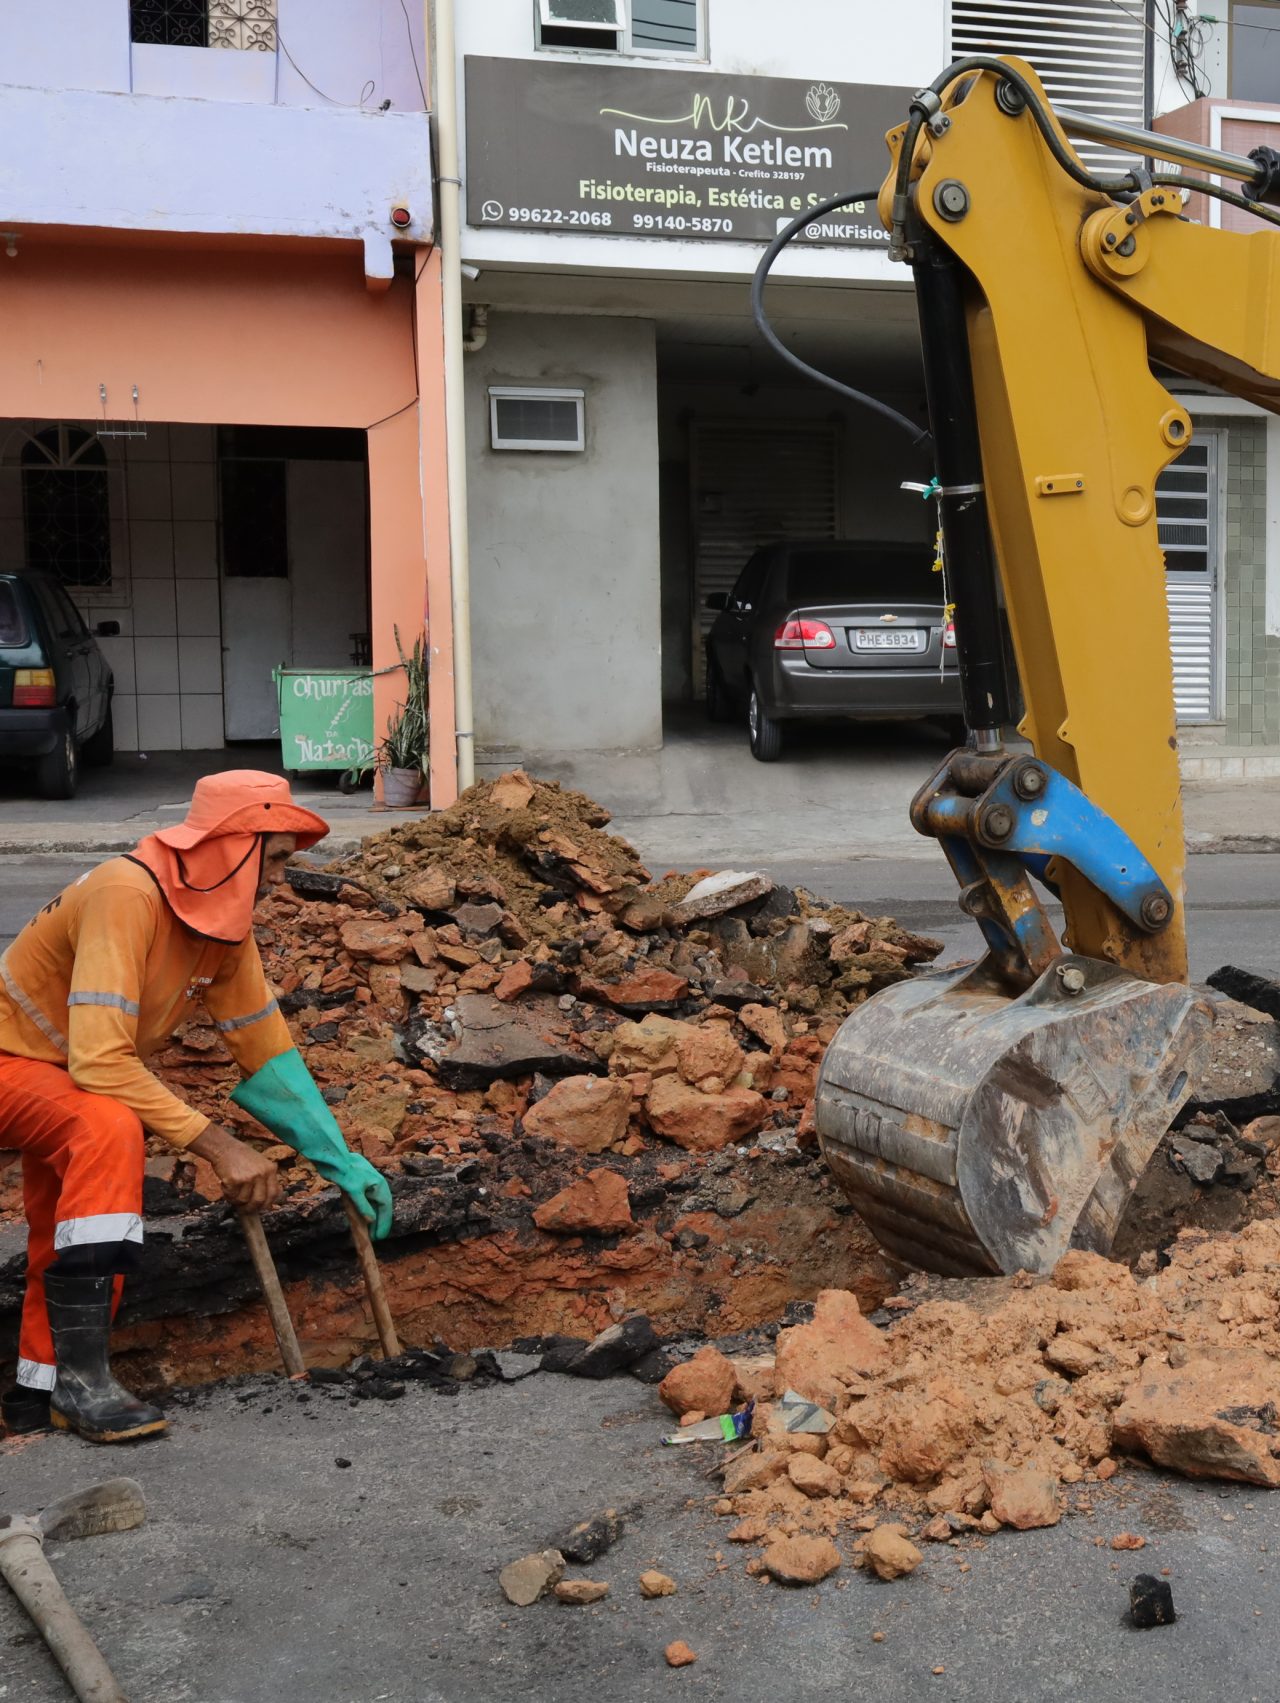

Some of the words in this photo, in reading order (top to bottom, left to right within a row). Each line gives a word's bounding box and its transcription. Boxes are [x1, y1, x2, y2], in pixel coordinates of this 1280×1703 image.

[614, 128, 712, 162] Neuza
[723, 135, 832, 168] Ketlem
[646, 162, 731, 176] Fisioterapeuta
[738, 169, 771, 179] Crefito
[772, 172, 805, 180] 328197
[579, 179, 702, 208] Fisioterapia,
[708, 186, 785, 210] Estética
[790, 197, 801, 211] e
[508, 207, 612, 226] 99622-2068
[633, 214, 733, 232] 99140-5870
[294, 735, 374, 764] Natach
